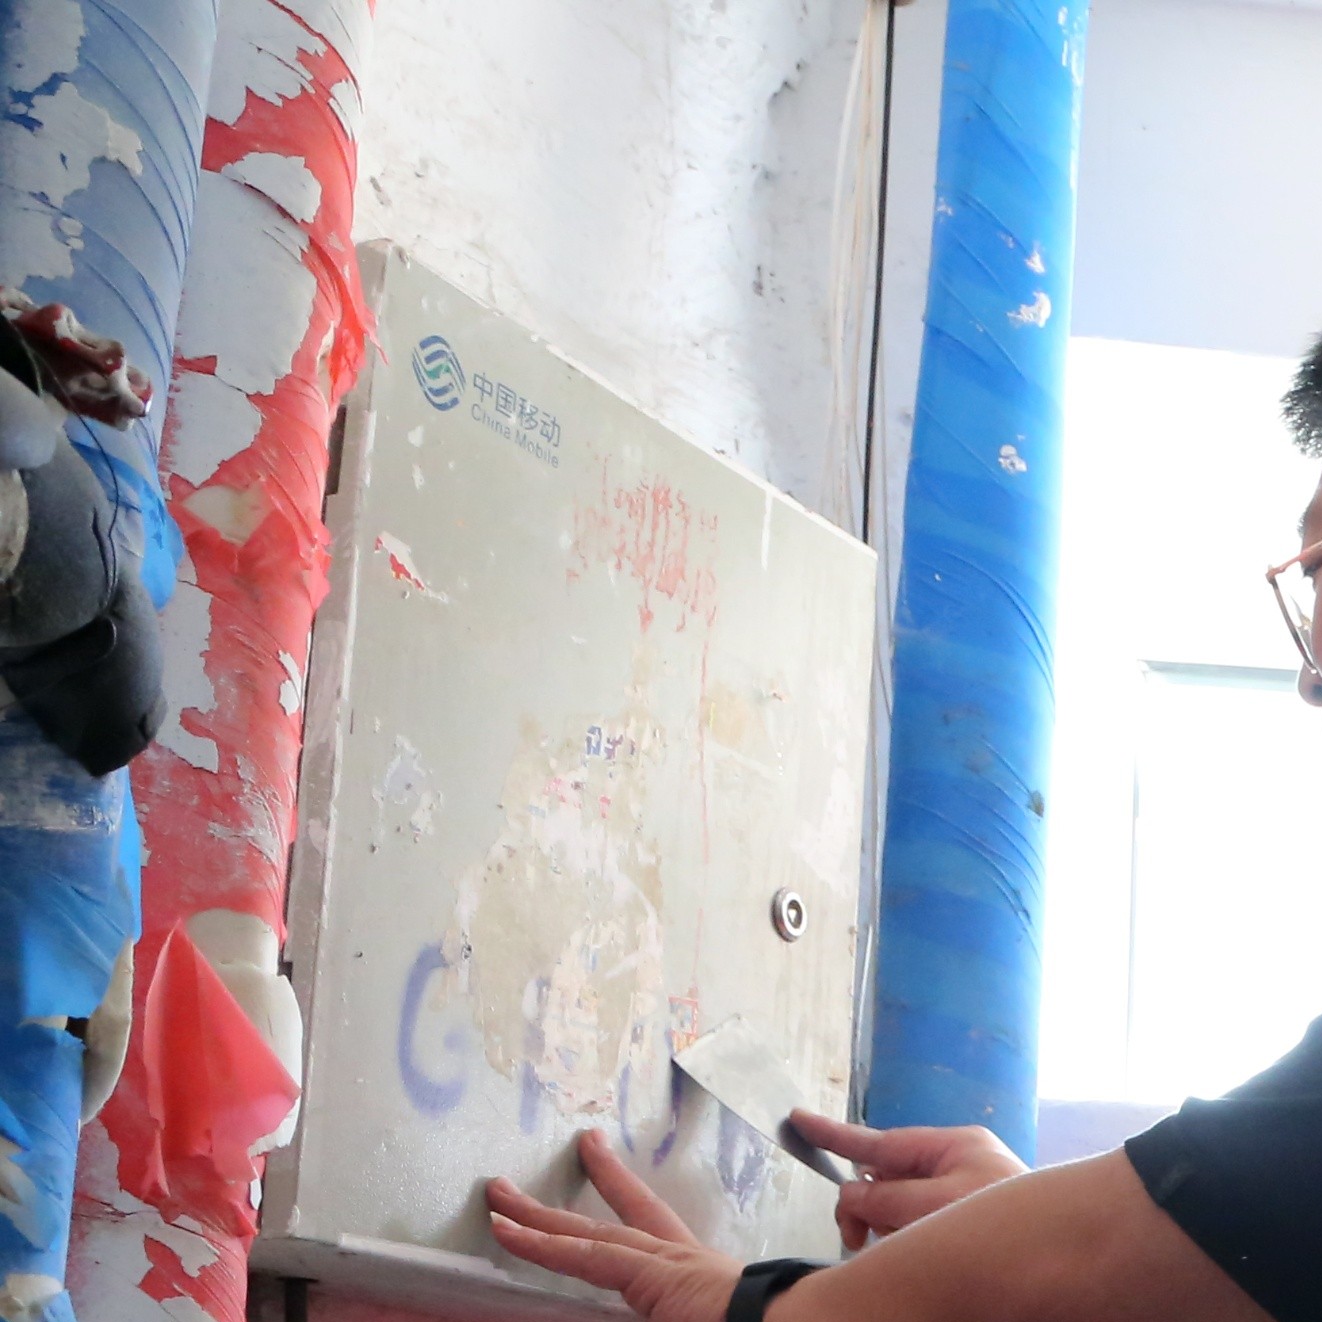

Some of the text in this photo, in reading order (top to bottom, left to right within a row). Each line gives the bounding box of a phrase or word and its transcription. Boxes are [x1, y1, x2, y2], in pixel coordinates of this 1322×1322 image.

[470, 402, 560, 469] China Mobile
[472, 372, 562, 448] 中国移动
